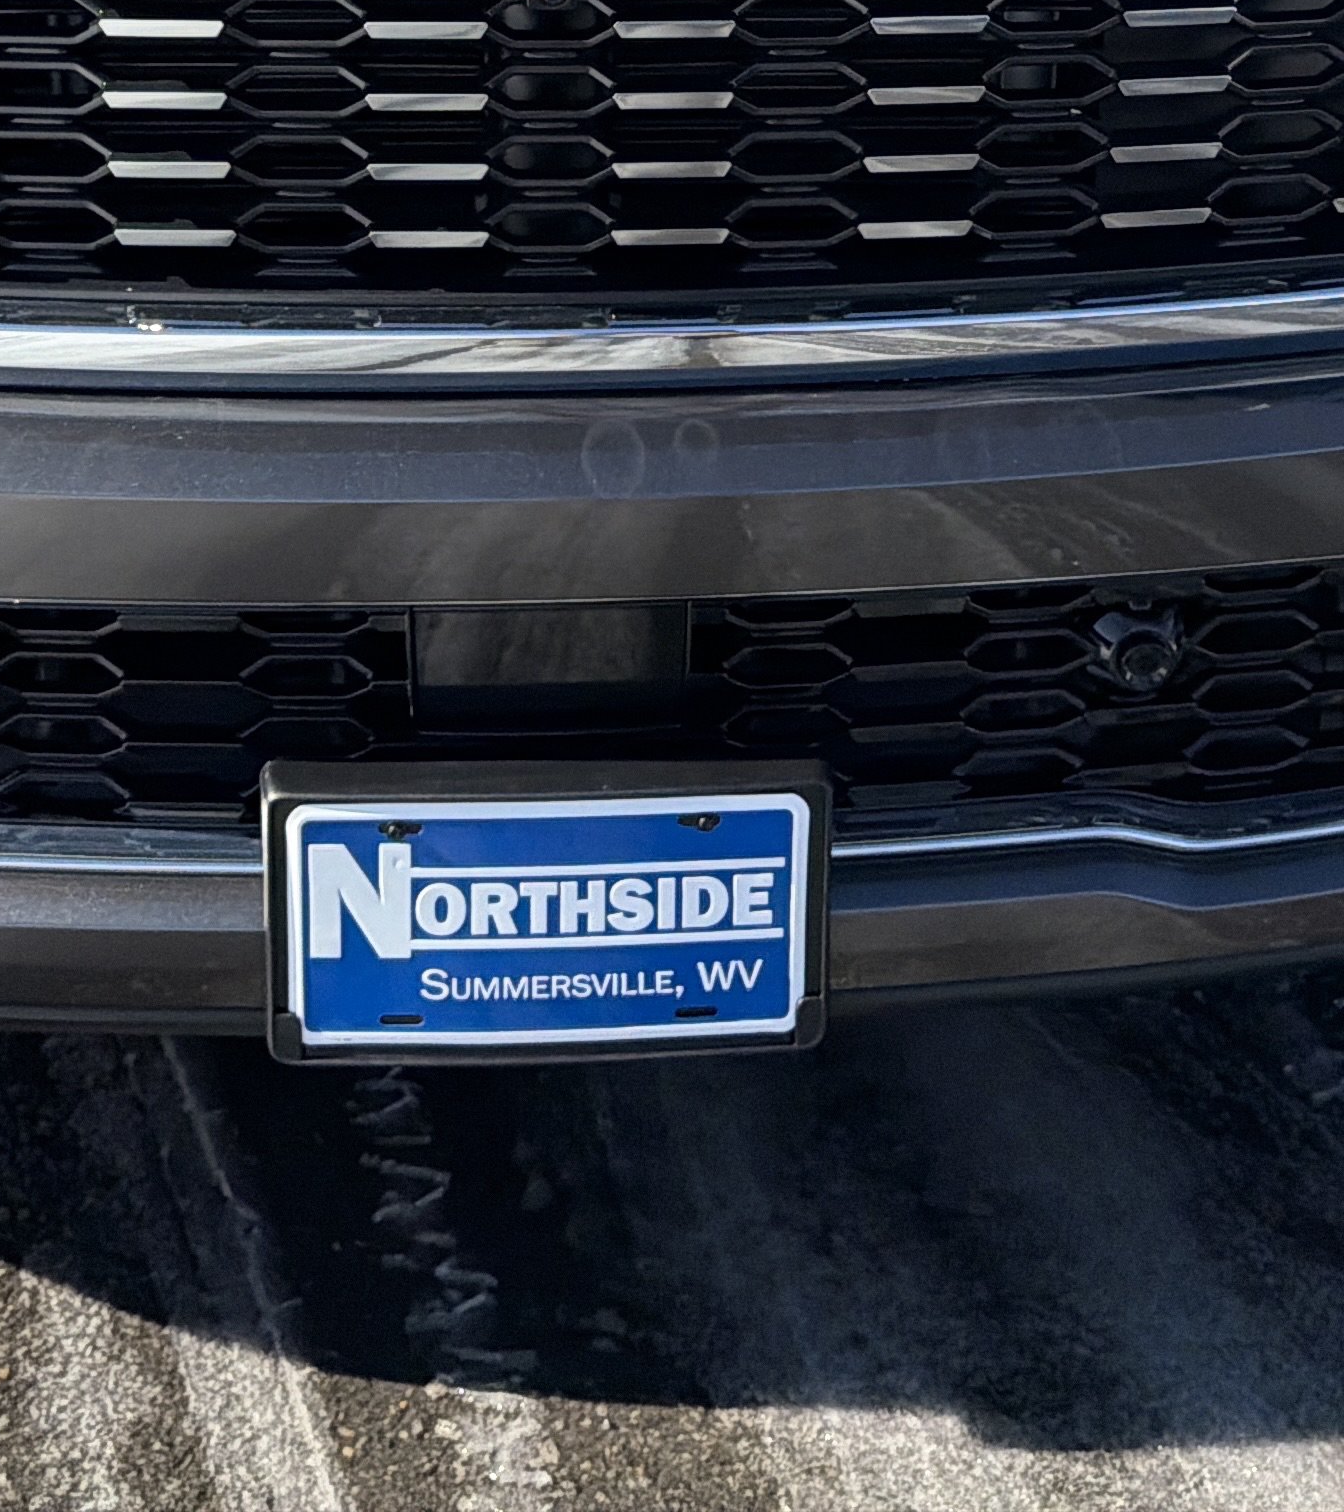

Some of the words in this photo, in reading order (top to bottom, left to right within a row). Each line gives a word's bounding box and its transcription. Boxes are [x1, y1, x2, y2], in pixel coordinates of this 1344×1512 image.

[307, 843, 775, 960] NORTHSIDE
[420, 967, 685, 1002] SUMMERSVILLE,
[696, 959, 764, 993] WV
